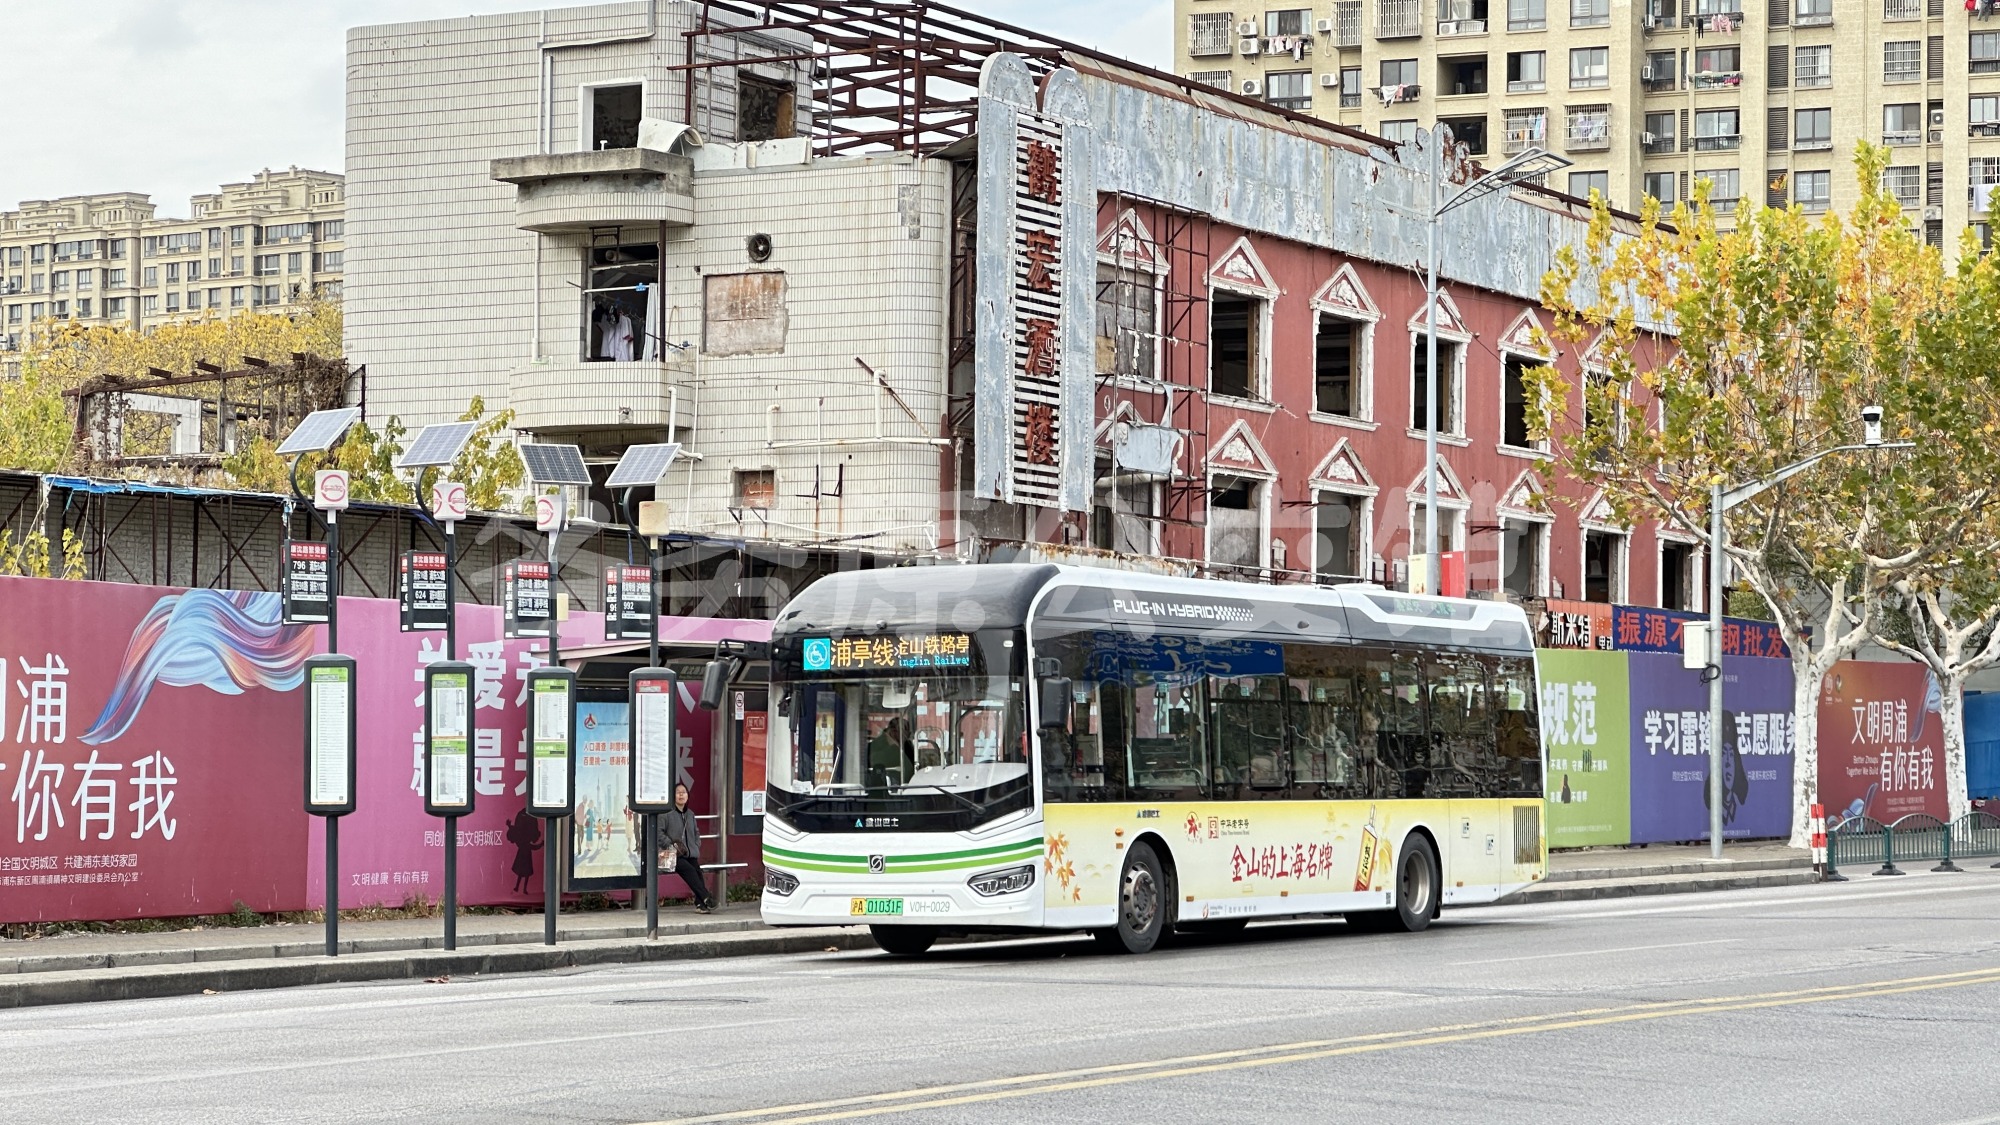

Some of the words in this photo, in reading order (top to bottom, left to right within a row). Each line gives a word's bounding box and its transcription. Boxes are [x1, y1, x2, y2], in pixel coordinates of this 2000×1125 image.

[293, 560, 306, 570] 796
[415, 590, 426, 599] 624
[623, 601, 634, 610] 992
[1167, 603, 1215, 619] HYBRID
[830, 638, 895, 667] 浦亭线
[1543, 681, 1597, 745] 规范
[1851, 698, 1908, 744] 文明周浦
[1880, 745, 1934, 792] 有你有我
[0, 749, 177, 843] 你有我
[865, 817, 899, 828] 金山巴士
[1220, 819, 1250, 829] 中华老字号
[424, 830, 503, 847] 同创国文明城区
[0, 856, 58, 871] 全国文明城区
[64, 854, 138, 868] 共建浦东美好家园
[1230, 842, 1333, 882] 金山的上海名牌
[352, 872, 389, 886] 文明健康
[393, 871, 429, 885] 有你有我
[867, 900, 902, 913] 01031F
